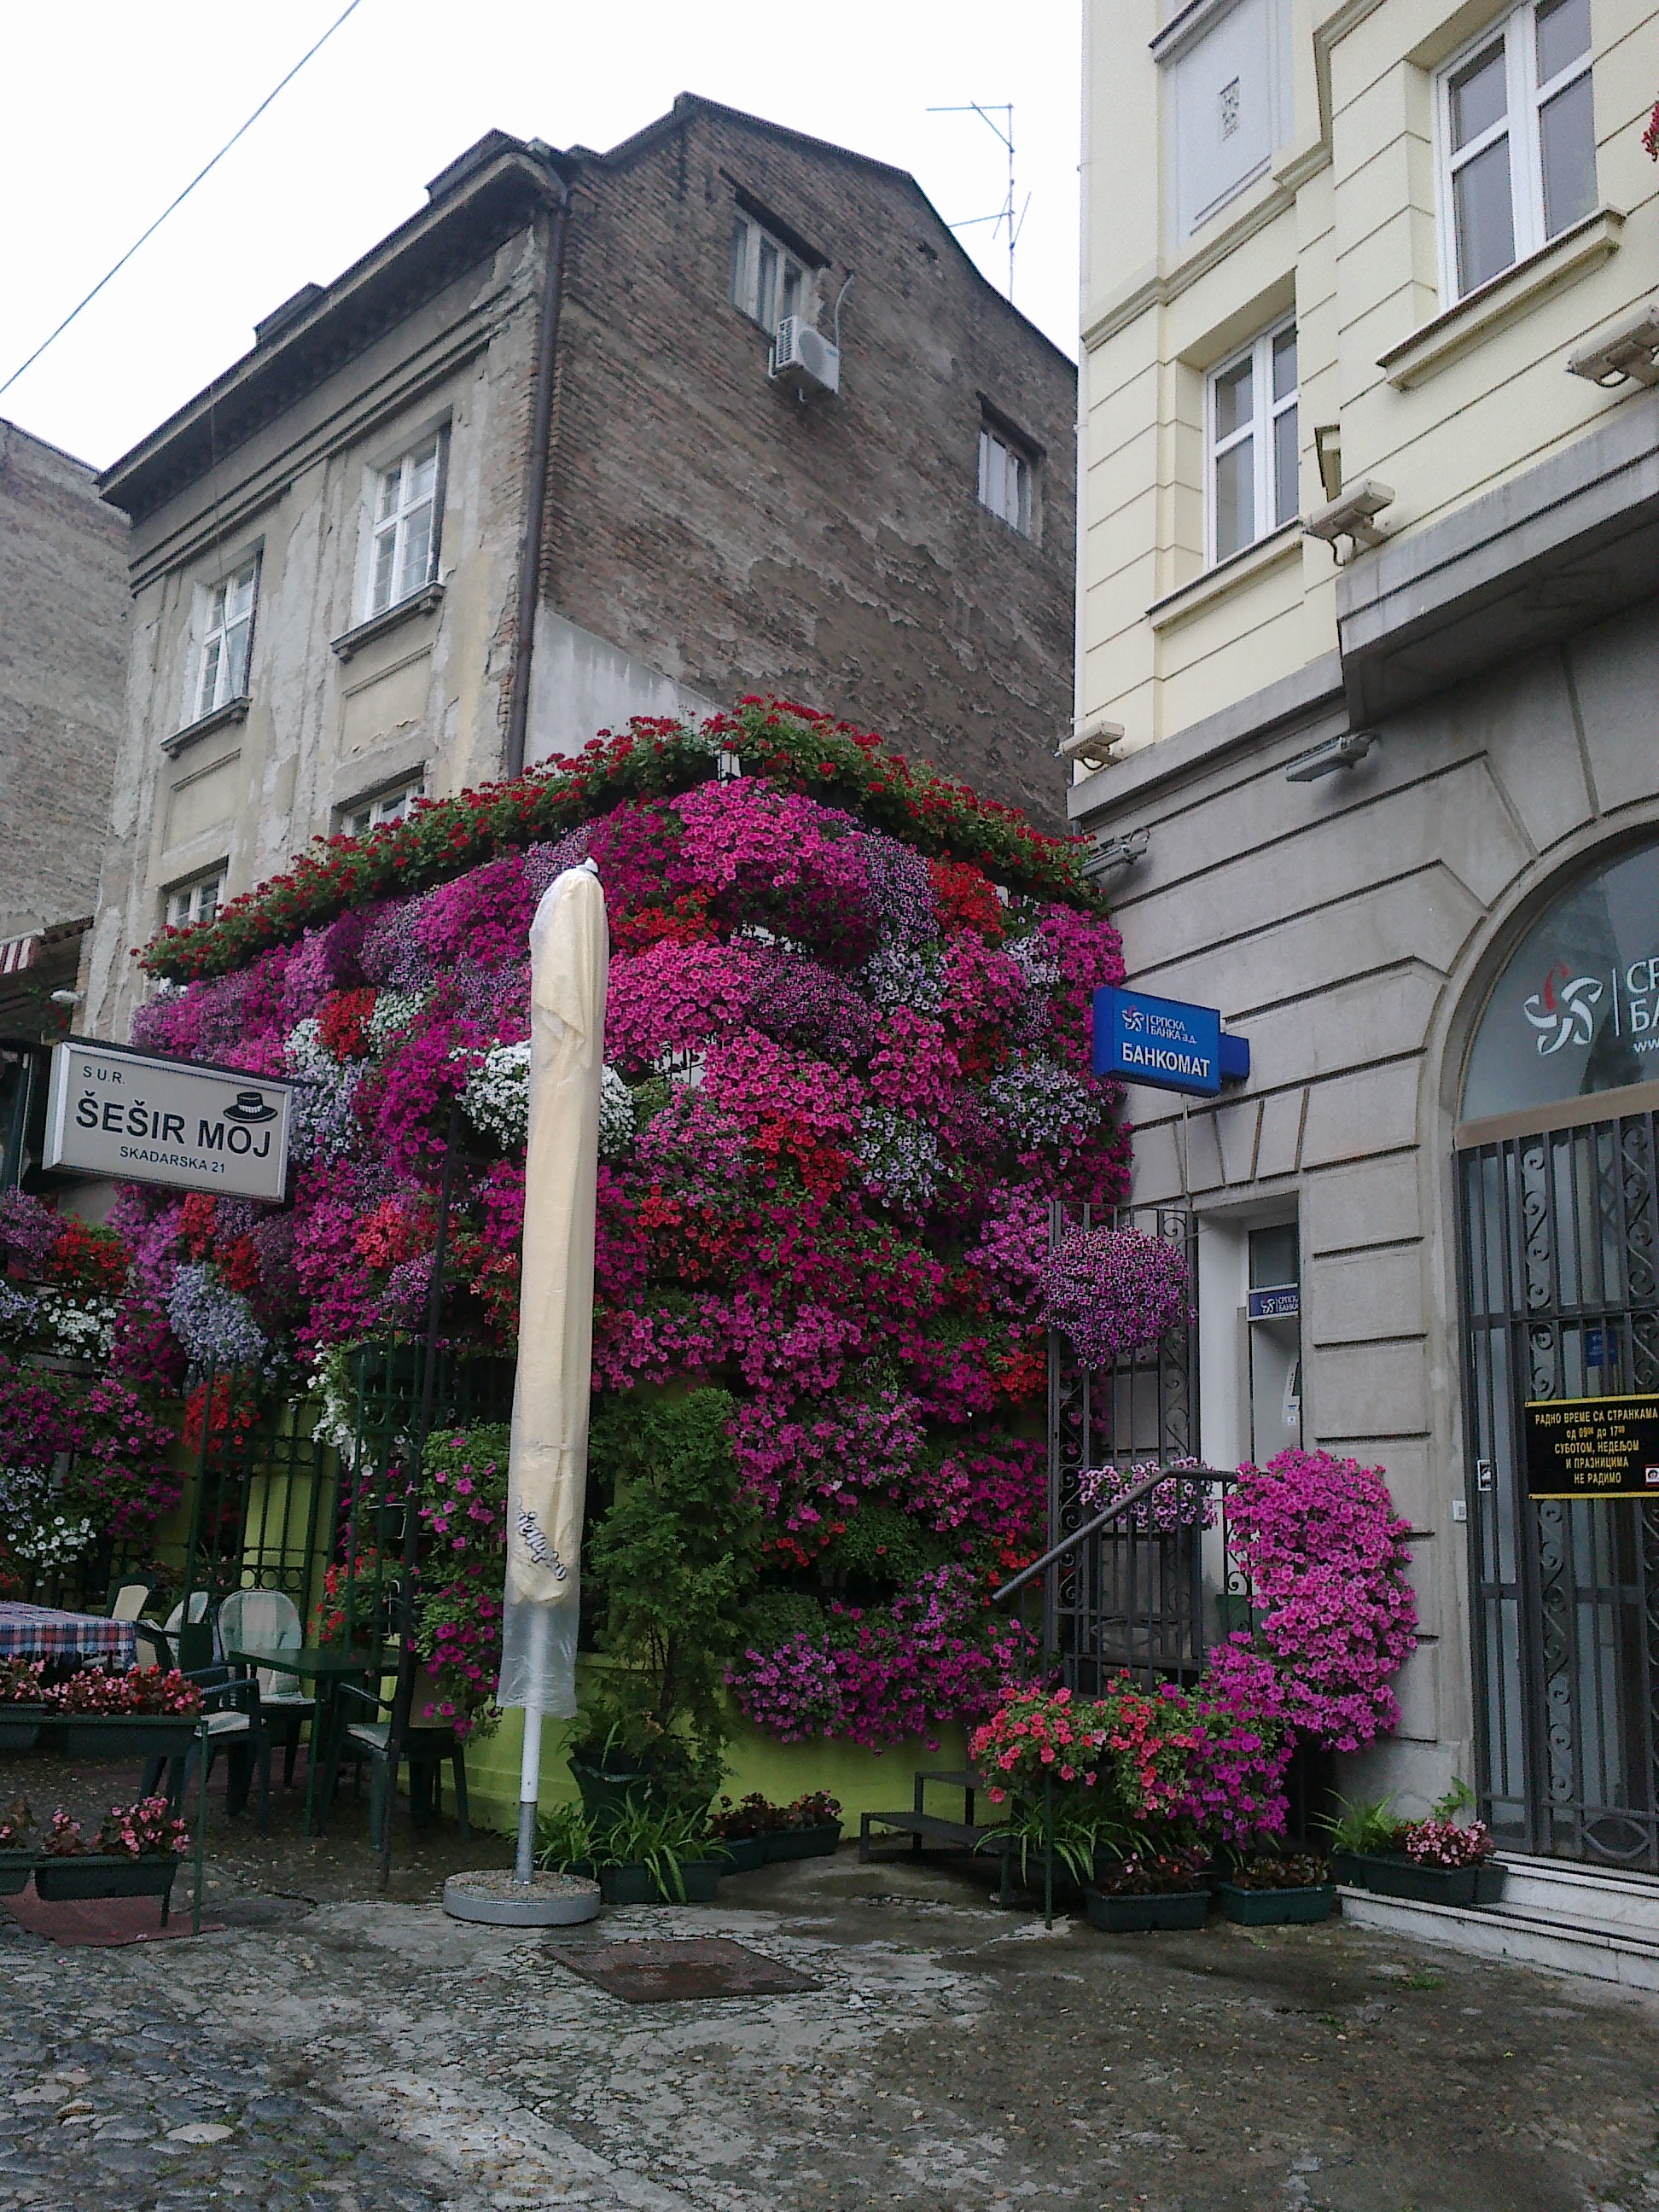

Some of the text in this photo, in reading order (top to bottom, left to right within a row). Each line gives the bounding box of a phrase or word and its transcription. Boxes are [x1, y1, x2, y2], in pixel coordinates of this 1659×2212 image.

[1150, 1015, 1185, 1031] СРПСКА
[1150, 1025, 1181, 1041] БАНКА
[1122, 1041, 1211, 1078] БАНКОМАТ
[76, 1090, 271, 1158] ŠEŠIR MOJ
[119, 1146, 225, 1173] SKADARSKA 21
[1535, 1407, 1658, 1427] РАДНО ВРЕМЕ СА СТРАНКАМА
[1554, 1440, 1639, 1455] СУБОТОМ, НЕДЕЉОМ
[1565, 1456, 1629, 1470] И ПРАЗНИЦИМА
[1574, 1471, 1622, 1486] НЕ РАДИМО
